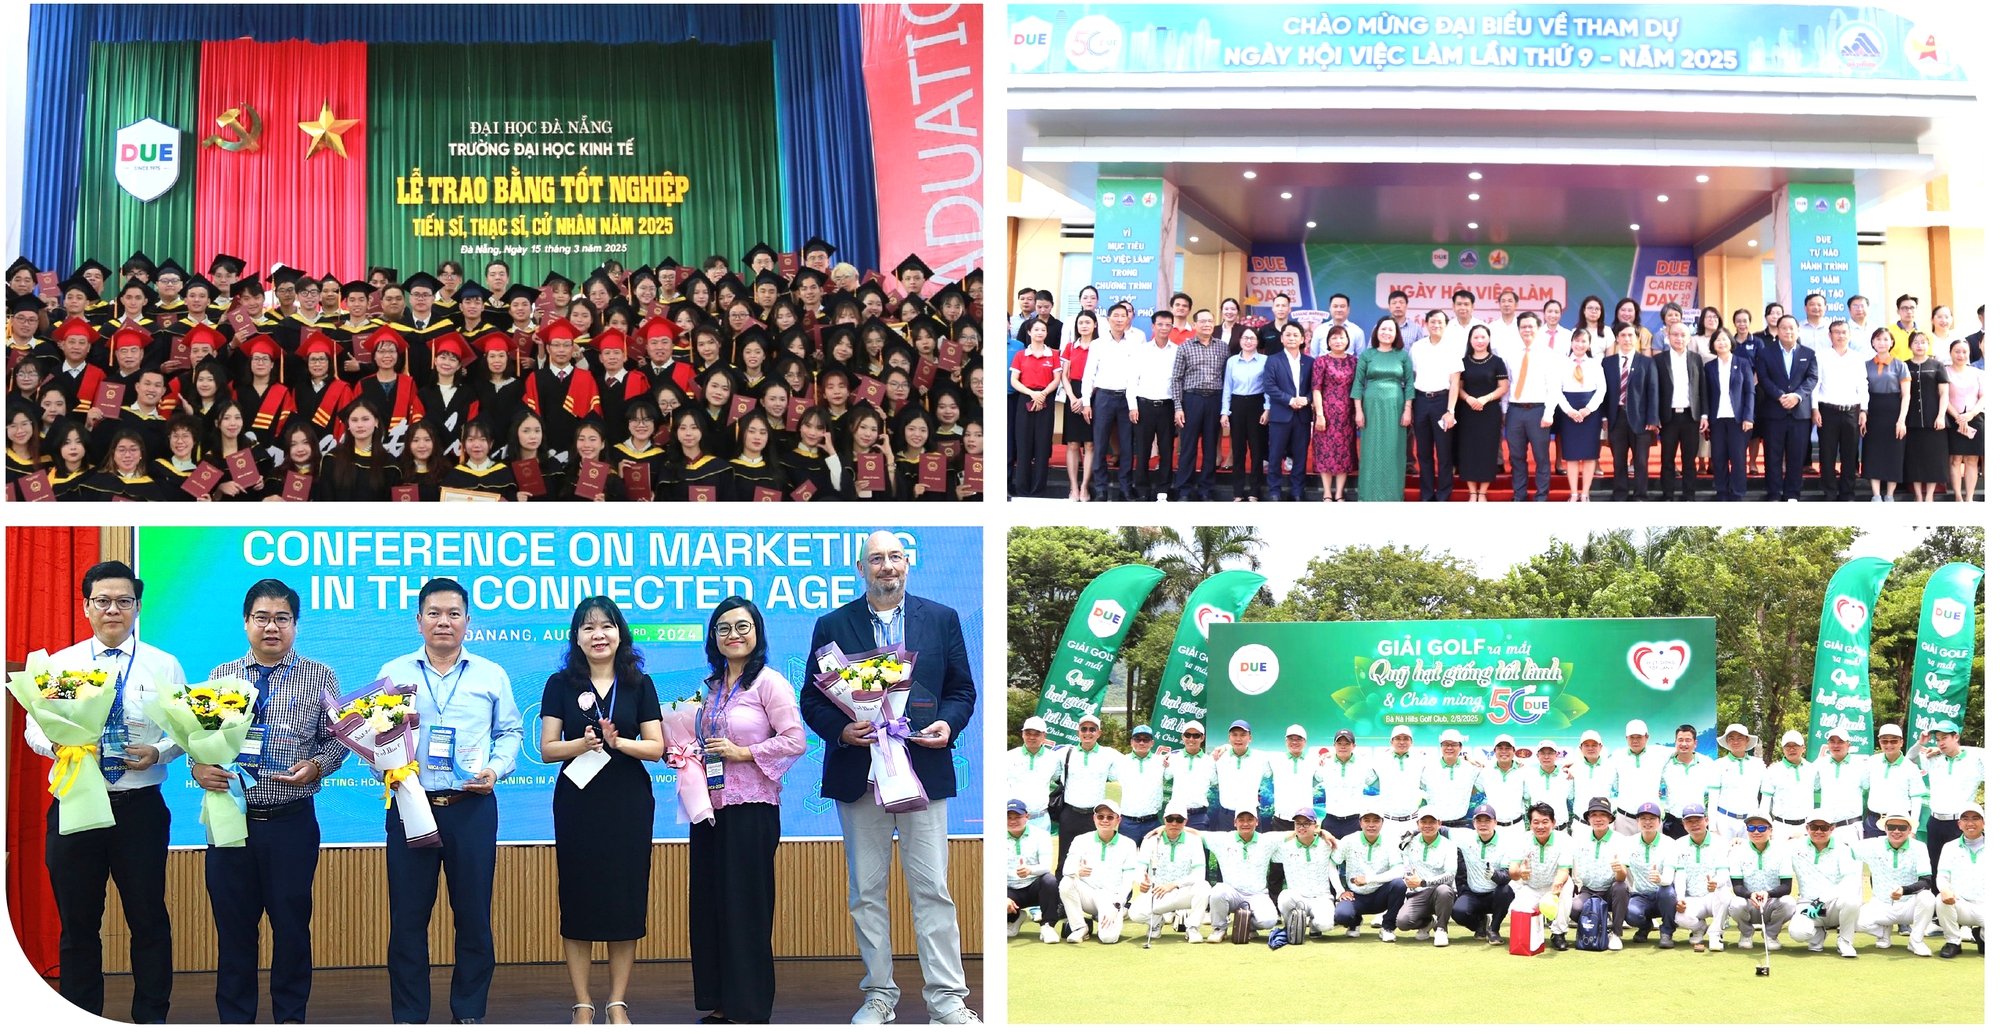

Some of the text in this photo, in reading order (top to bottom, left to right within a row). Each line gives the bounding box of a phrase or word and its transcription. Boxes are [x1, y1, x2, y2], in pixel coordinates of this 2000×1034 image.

[1283, 10, 1679, 43] CHÀO MỪNG ĐẠI BIỂU VỀ THAM DỰ
[1014, 33, 1047, 46] DUE
[1224, 42, 1738, 71] NGÀY HỘI VIỆC LÀM LẦN THỨ 9 NĂM 2025
[470, 115, 613, 137] ĐẠI HỌC ĐÀ NẴNG
[121, 144, 172, 162] DUE
[449, 138, 634, 159] TRƯỜNG ĐẠI HỌC KINH TẾ
[397, 166, 690, 208] LỄ TRAO BẰNG TỐT NGHIỆP
[413, 212, 673, 240] TIẾN SĨ, THẠC SĨ, CỬ NHÂN NĂM 2025
[1123, 228, 1131, 237] VÌ
[1108, 240, 1145, 252] MỤC TIÊU
[1816, 236, 1832, 244] DUE
[460, 244, 473, 254] Đà
[504, 244, 528, 256] Ngày
[531, 244, 541, 253] 15
[544, 244, 572, 256] tháng
[574, 244, 580, 253] 3
[582, 244, 602, 253] năm
[604, 244, 628, 253] 2025
[1809, 248, 1839, 258] TỰ HÀO
[1113, 254, 1131, 265] VIỆC
[1252, 256, 1287, 271] DUE
[1801, 261, 1848, 270] HÀNH TRÌNH
[1112, 269, 1138, 277] TRONG
[1656, 260, 1690, 275] DUE
[1095, 281, 1152, 290] CHƯƠNG TRÌNH
[1250, 276, 1294, 286] CAREER
[1649, 280, 1693, 291] CAREER
[1810, 274, 1840, 284] 50 NĂM
[1252, 289, 1283, 302] DAY
[1390, 282, 1553, 300] NGÀY LÀM
[1828, 289, 1844, 299] TẠO
[1645, 293, 1679, 306] DAY
[1137, 306, 1155, 317] PHỐ
[243, 530, 555, 566] CONFERENCE
[569, 532, 632, 566] ON
[311, 576, 855, 610] IN TH CONNECTED AGE
[1093, 607, 1121, 624] DUE
[1936, 607, 1961, 620] DUE
[658, 628, 697, 641] 2024
[1067, 640, 1090, 654] GIẢI
[1178, 646, 1197, 658] GIẢI
[1377, 634, 1532, 656] GIẢI GOLF ra mắt
[1824, 640, 1843, 651] GIẢI
[1921, 642, 1969, 659] GIẢI GOLF
[1073, 656, 1103, 672] ra mắt
[1240, 662, 1267, 672] DUE
[1369, 656, 1563, 688] Quỹ hạt giống tốt lành
[1066, 669, 1094, 692] Quỹ
[1180, 674, 1204, 696] Quỹ
[1925, 672, 1951, 694] Quỹ
[1045, 685, 1098, 715] hạt giống
[1383, 692, 1485, 712] & Chào mừng
[1816, 687, 1837, 707] hạt
[1913, 689, 1961, 717] hạt giống
[1161, 691, 1207, 718] hạt giống
[1524, 701, 1549, 710] DUE
[1043, 708, 1062, 724] tốt
[1160, 715, 1177, 730] tốt
[1405, 715, 1418, 723] Hills
[1420, 715, 1432, 723] Golf
[1433, 715, 1449, 723] Club,
[1154, 732, 1179, 743] & Chào
[1815, 730, 1822, 739] &
[495, 776, 545, 785] EANING IN
